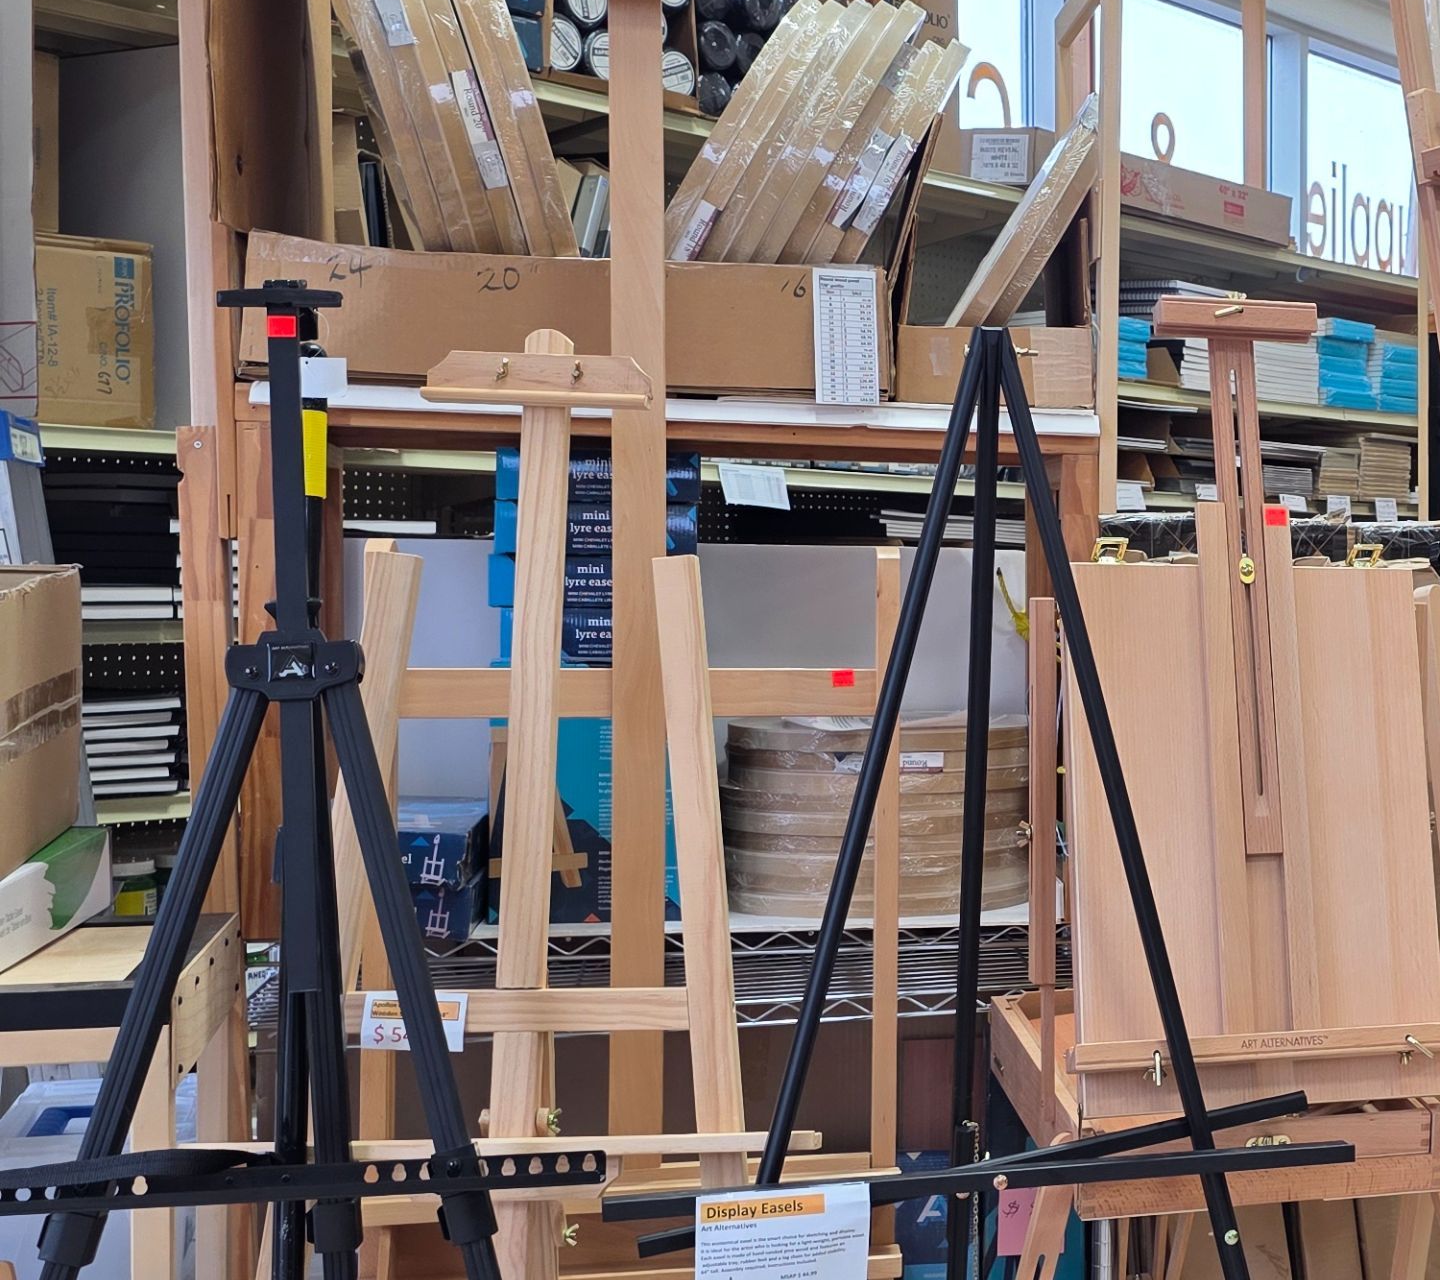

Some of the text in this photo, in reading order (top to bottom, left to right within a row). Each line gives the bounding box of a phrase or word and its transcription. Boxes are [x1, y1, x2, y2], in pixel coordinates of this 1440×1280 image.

[114, 282, 131, 383] PROFOLIO
[573, 470, 594, 481] lyre
[583, 511, 610, 520] mini
[570, 523, 592, 534] lyre
[577, 564, 604, 573] mini
[565, 577, 586, 588] lyre
[588, 617, 612, 626] min
[576, 629, 597, 641] lyre
[373, 1024, 384, 1045] $
[1241, 1037, 1257, 1049] ART
[707, 1200, 803, 1219] Display Easels
[701, 1222, 757, 1232] Art Alternatives
